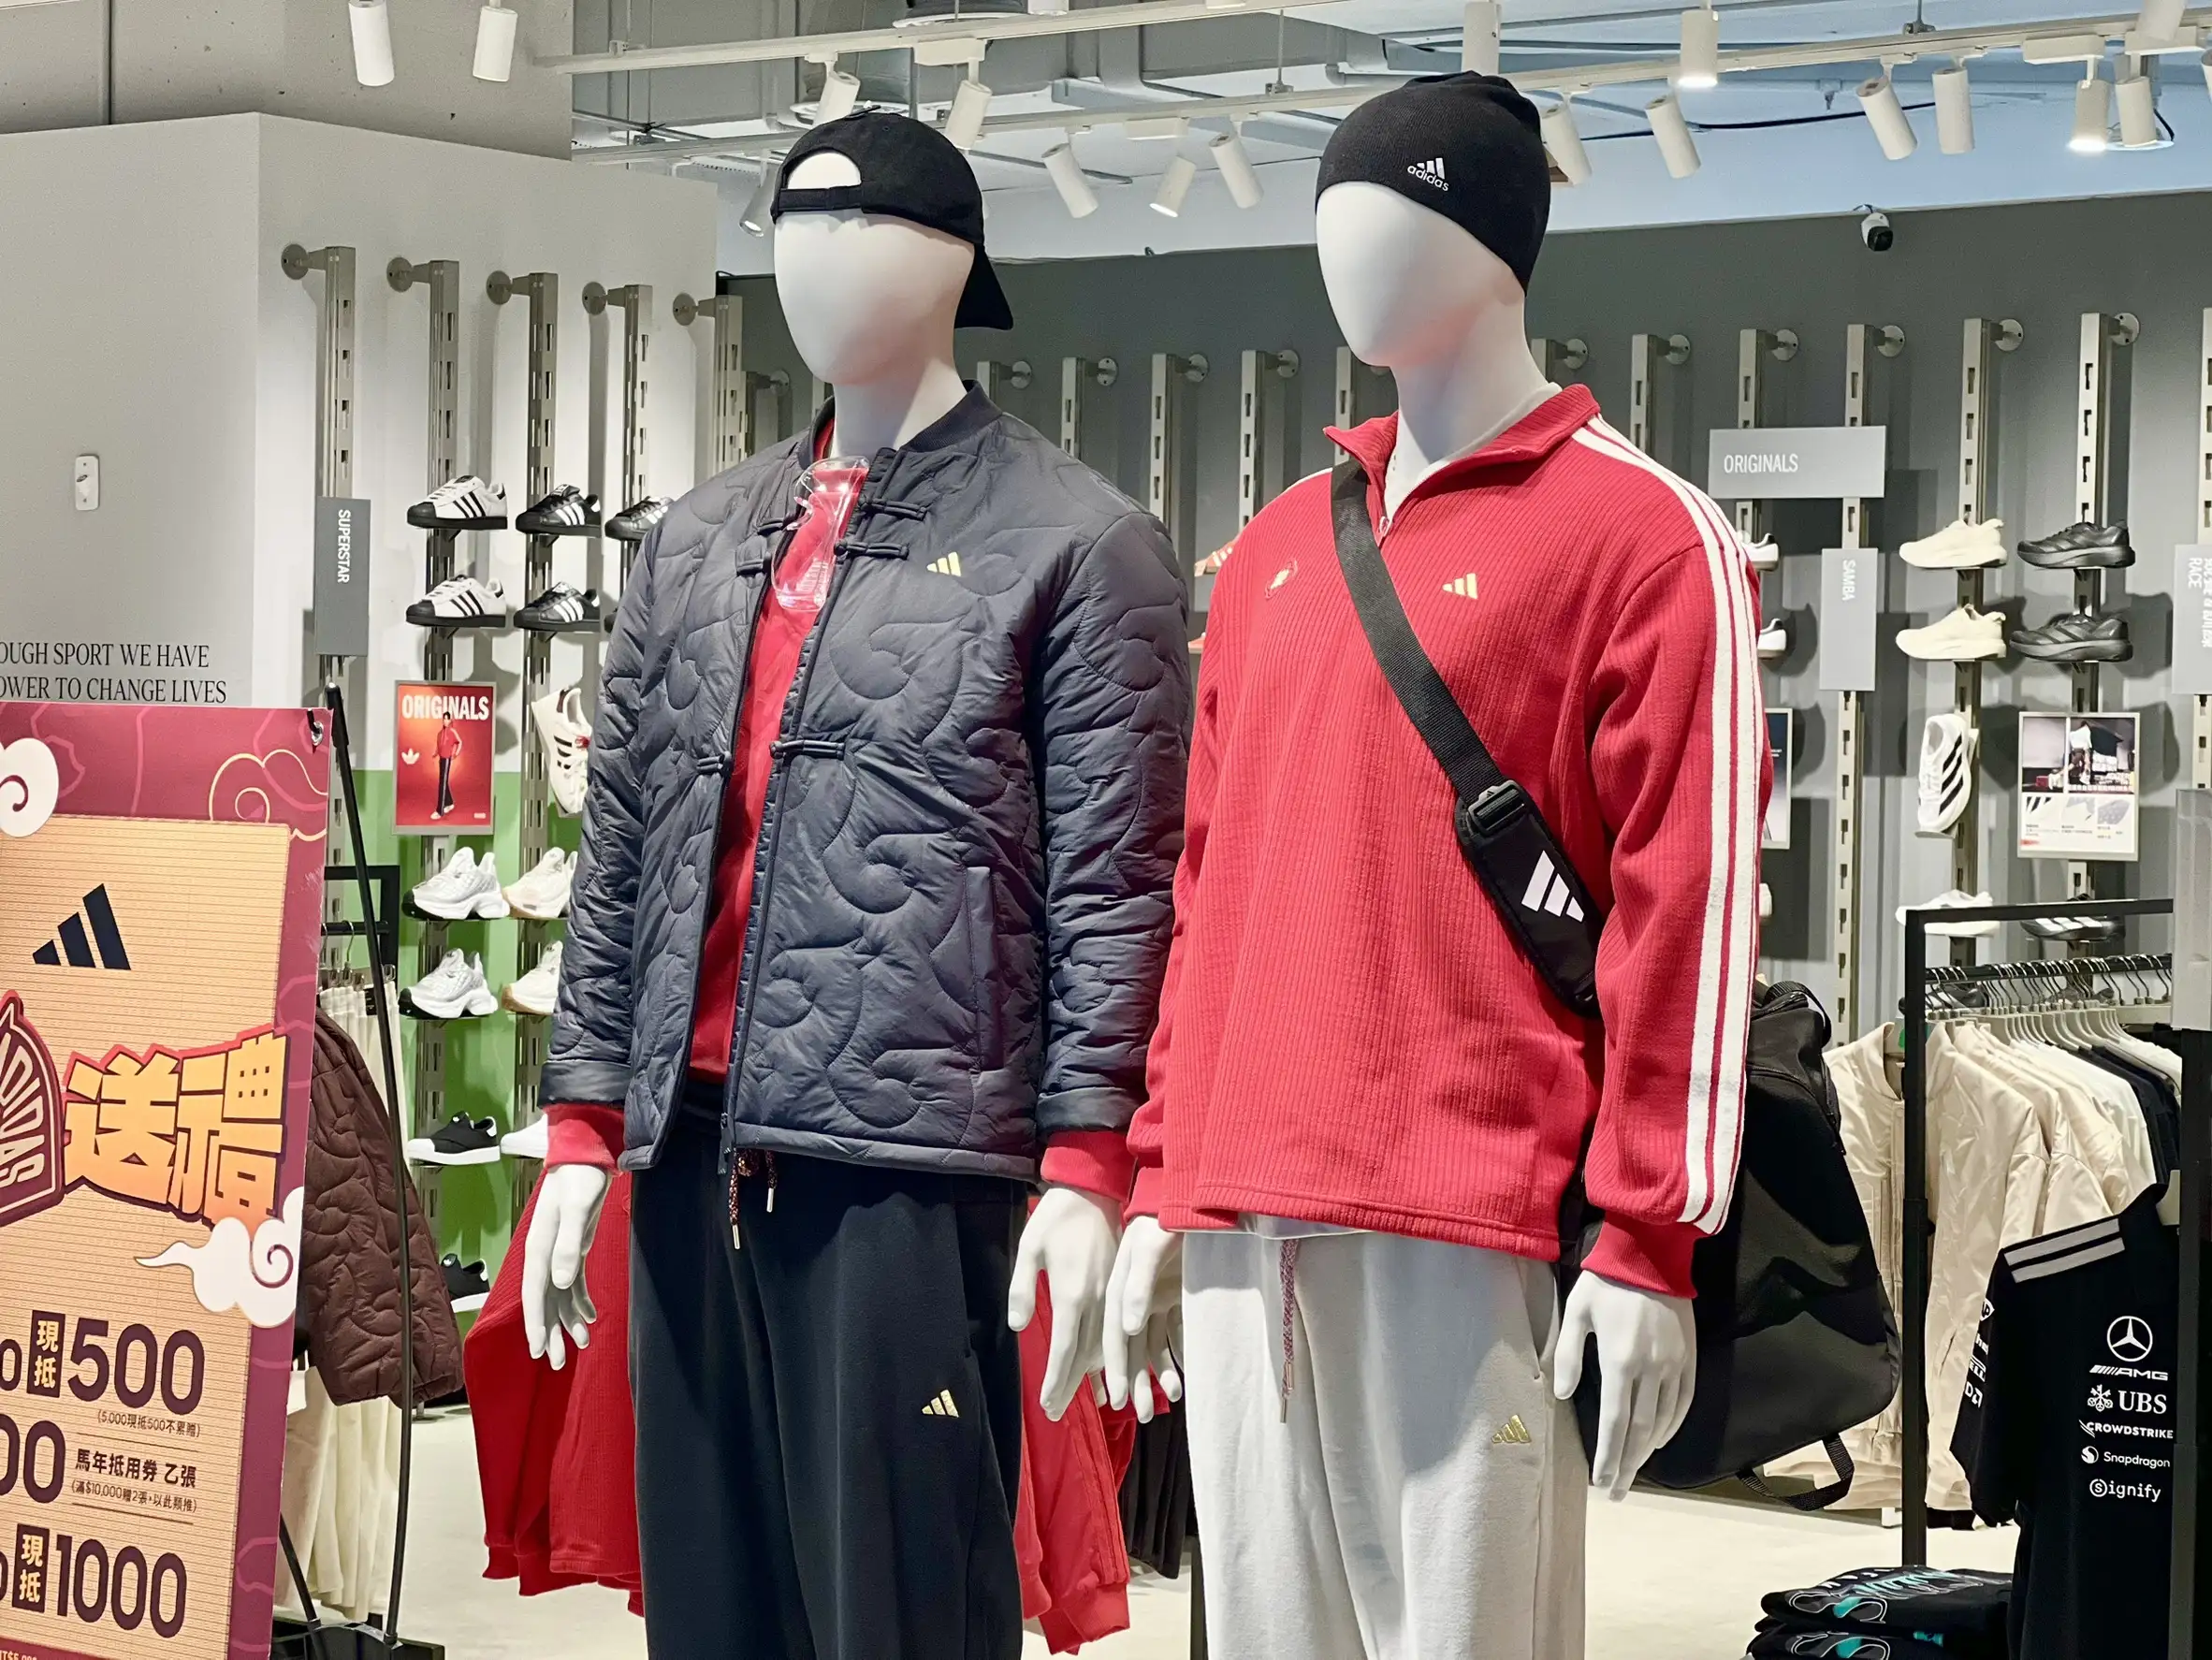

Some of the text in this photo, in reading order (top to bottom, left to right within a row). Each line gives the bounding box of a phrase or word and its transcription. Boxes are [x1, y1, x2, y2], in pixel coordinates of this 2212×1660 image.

[1406, 165, 1449, 192] adidas
[1724, 453, 1798, 473] ORIGINALS
[337, 509, 351, 583] SUPERSTAR
[1841, 560, 1856, 601] SAMBA
[2188, 558, 2203, 589] RACE
[0, 642, 210, 668] OUGH SPORT WE HAVE
[55, 677, 81, 700] TO
[86, 677, 167, 702] CHANGE
[171, 679, 226, 704] LIVES
[401, 694, 489, 721] ORIGINALS
[63, 1030, 288, 1230] 送禮
[33, 1318, 60, 1390] 現抵
[66, 1317, 206, 1415] 500
[2115, 1366, 2169, 1382] AMG
[2117, 1390, 2168, 1415] UBS
[2085, 1420, 2175, 1439] CROWDSTRIKE
[75, 1449, 158, 1482] 馬年抵用券
[164, 1463, 197, 1488] 乙張
[2103, 1451, 2171, 1470] Snapdragon
[19, 1534, 44, 1603] 現抵
[56, 1534, 187, 1638] 1000
